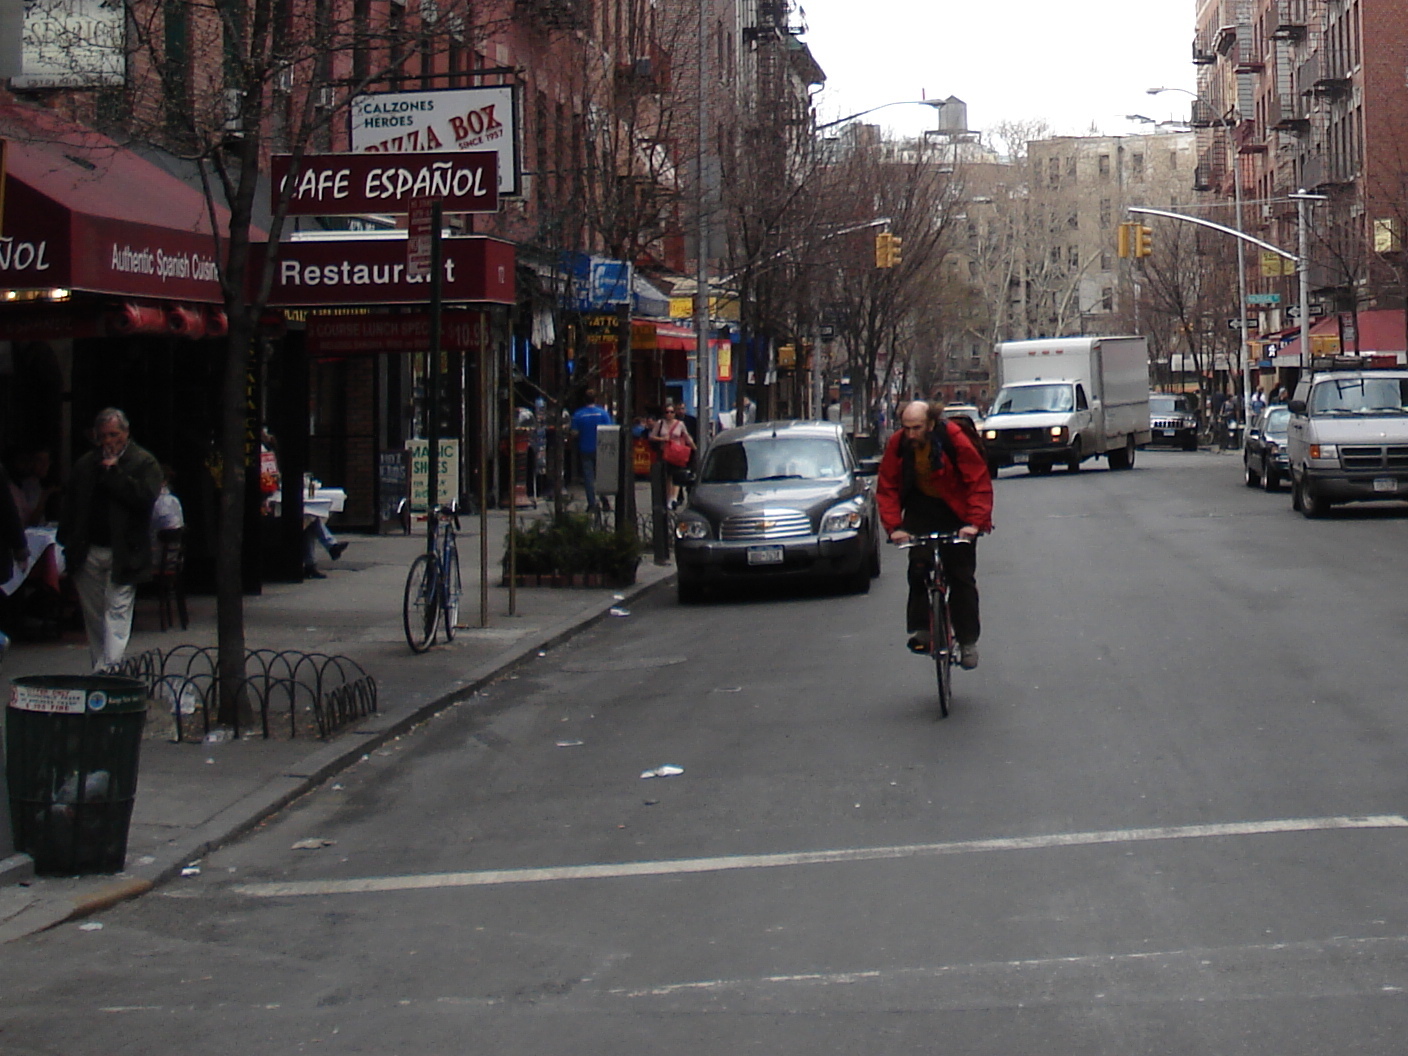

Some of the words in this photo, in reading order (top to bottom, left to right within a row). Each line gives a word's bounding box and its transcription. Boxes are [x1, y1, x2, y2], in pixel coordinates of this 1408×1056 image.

[364, 100, 434, 114] CALZONES
[365, 115, 413, 128] HEROES
[449, 104, 502, 141] BOX
[458, 137, 484, 150] SINCE
[365, 160, 487, 200] ESPAÑOL
[112, 242, 154, 275] Authentic
[156, 247, 190, 283] Spanish
[281, 259, 455, 287] Restaurt
[413, 446, 453, 458] MAIC
